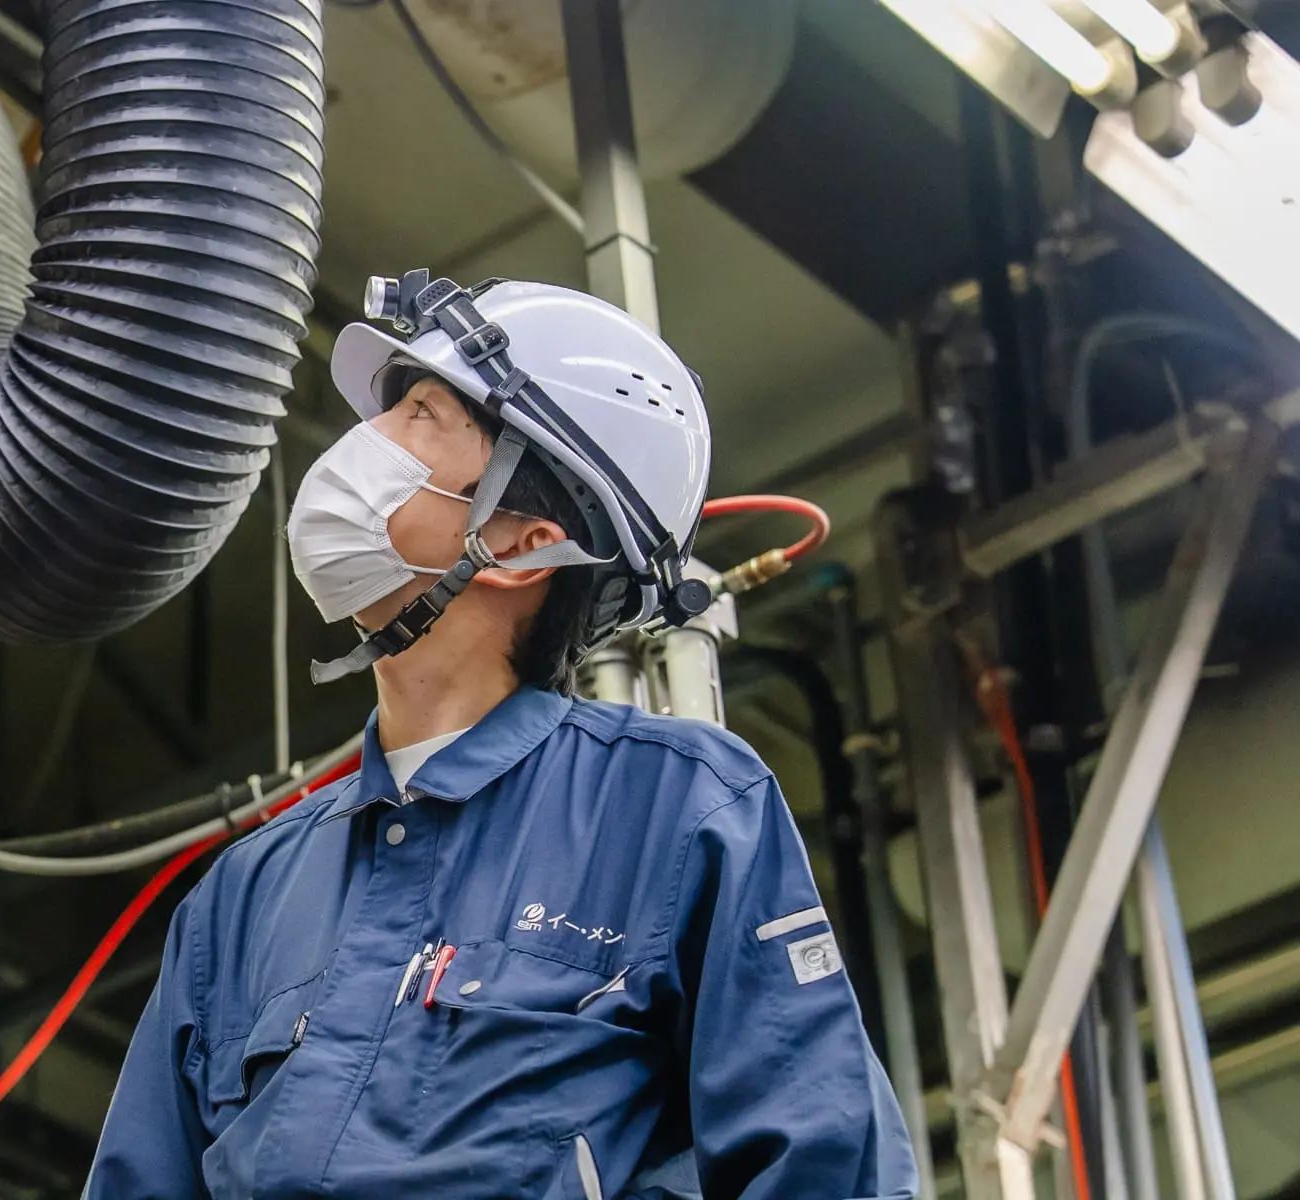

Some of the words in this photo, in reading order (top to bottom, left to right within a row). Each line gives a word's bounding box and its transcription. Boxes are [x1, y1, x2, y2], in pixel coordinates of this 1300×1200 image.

[547, 913, 626, 945] イー・メン
